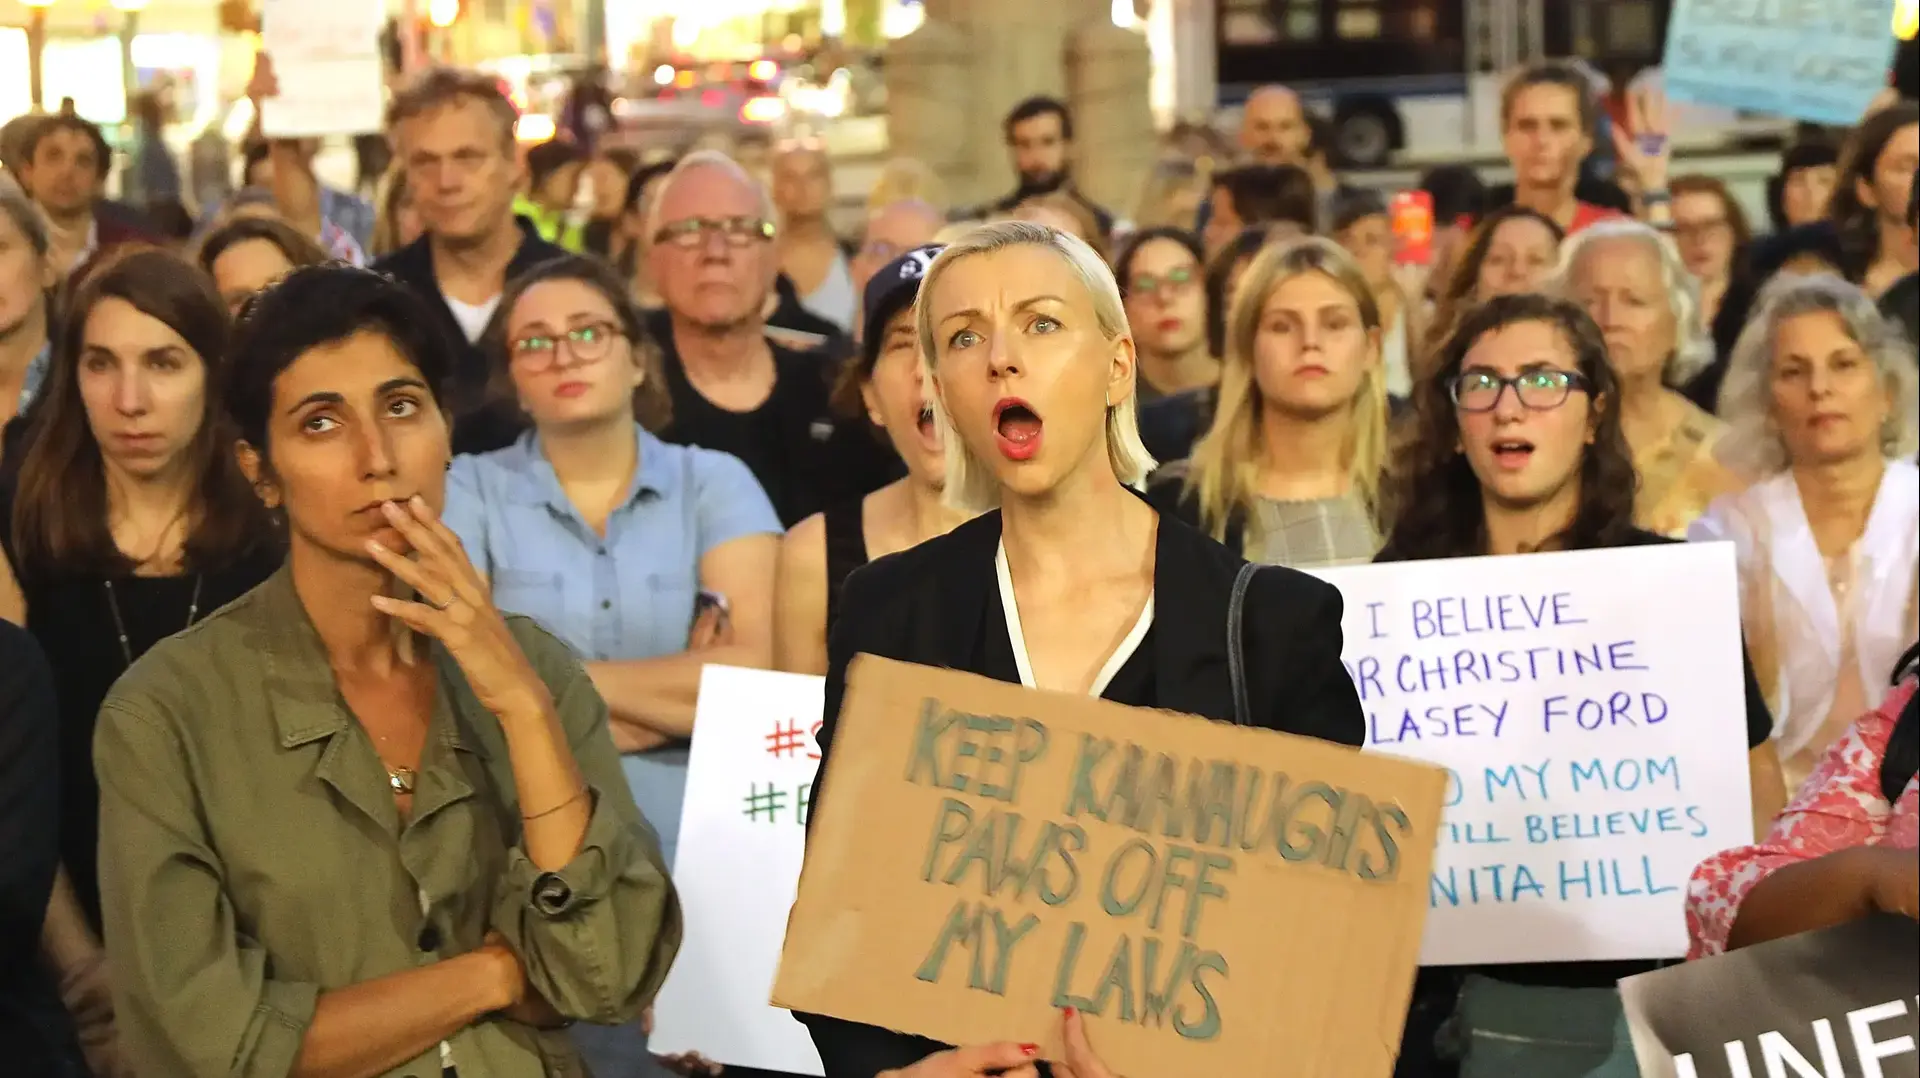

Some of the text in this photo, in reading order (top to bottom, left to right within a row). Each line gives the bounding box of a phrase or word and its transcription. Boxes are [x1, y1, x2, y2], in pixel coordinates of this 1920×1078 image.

[1365, 592, 1588, 639] I BELIEVE
[1343, 640, 1649, 700] R CHRISTINE
[1370, 691, 1668, 744] LASEY FORD
[904, 697, 1049, 803] KEEP
[1484, 758, 1551, 802] MY
[1570, 756, 1681, 793] MOM
[1440, 805, 1708, 844] ILL BELIEVES
[921, 797, 1236, 937] PAWS OFF
[1429, 854, 1679, 908] NITA HILL
[913, 898, 1230, 1040] MY LAWS
[1673, 994, 1919, 1078] NF
